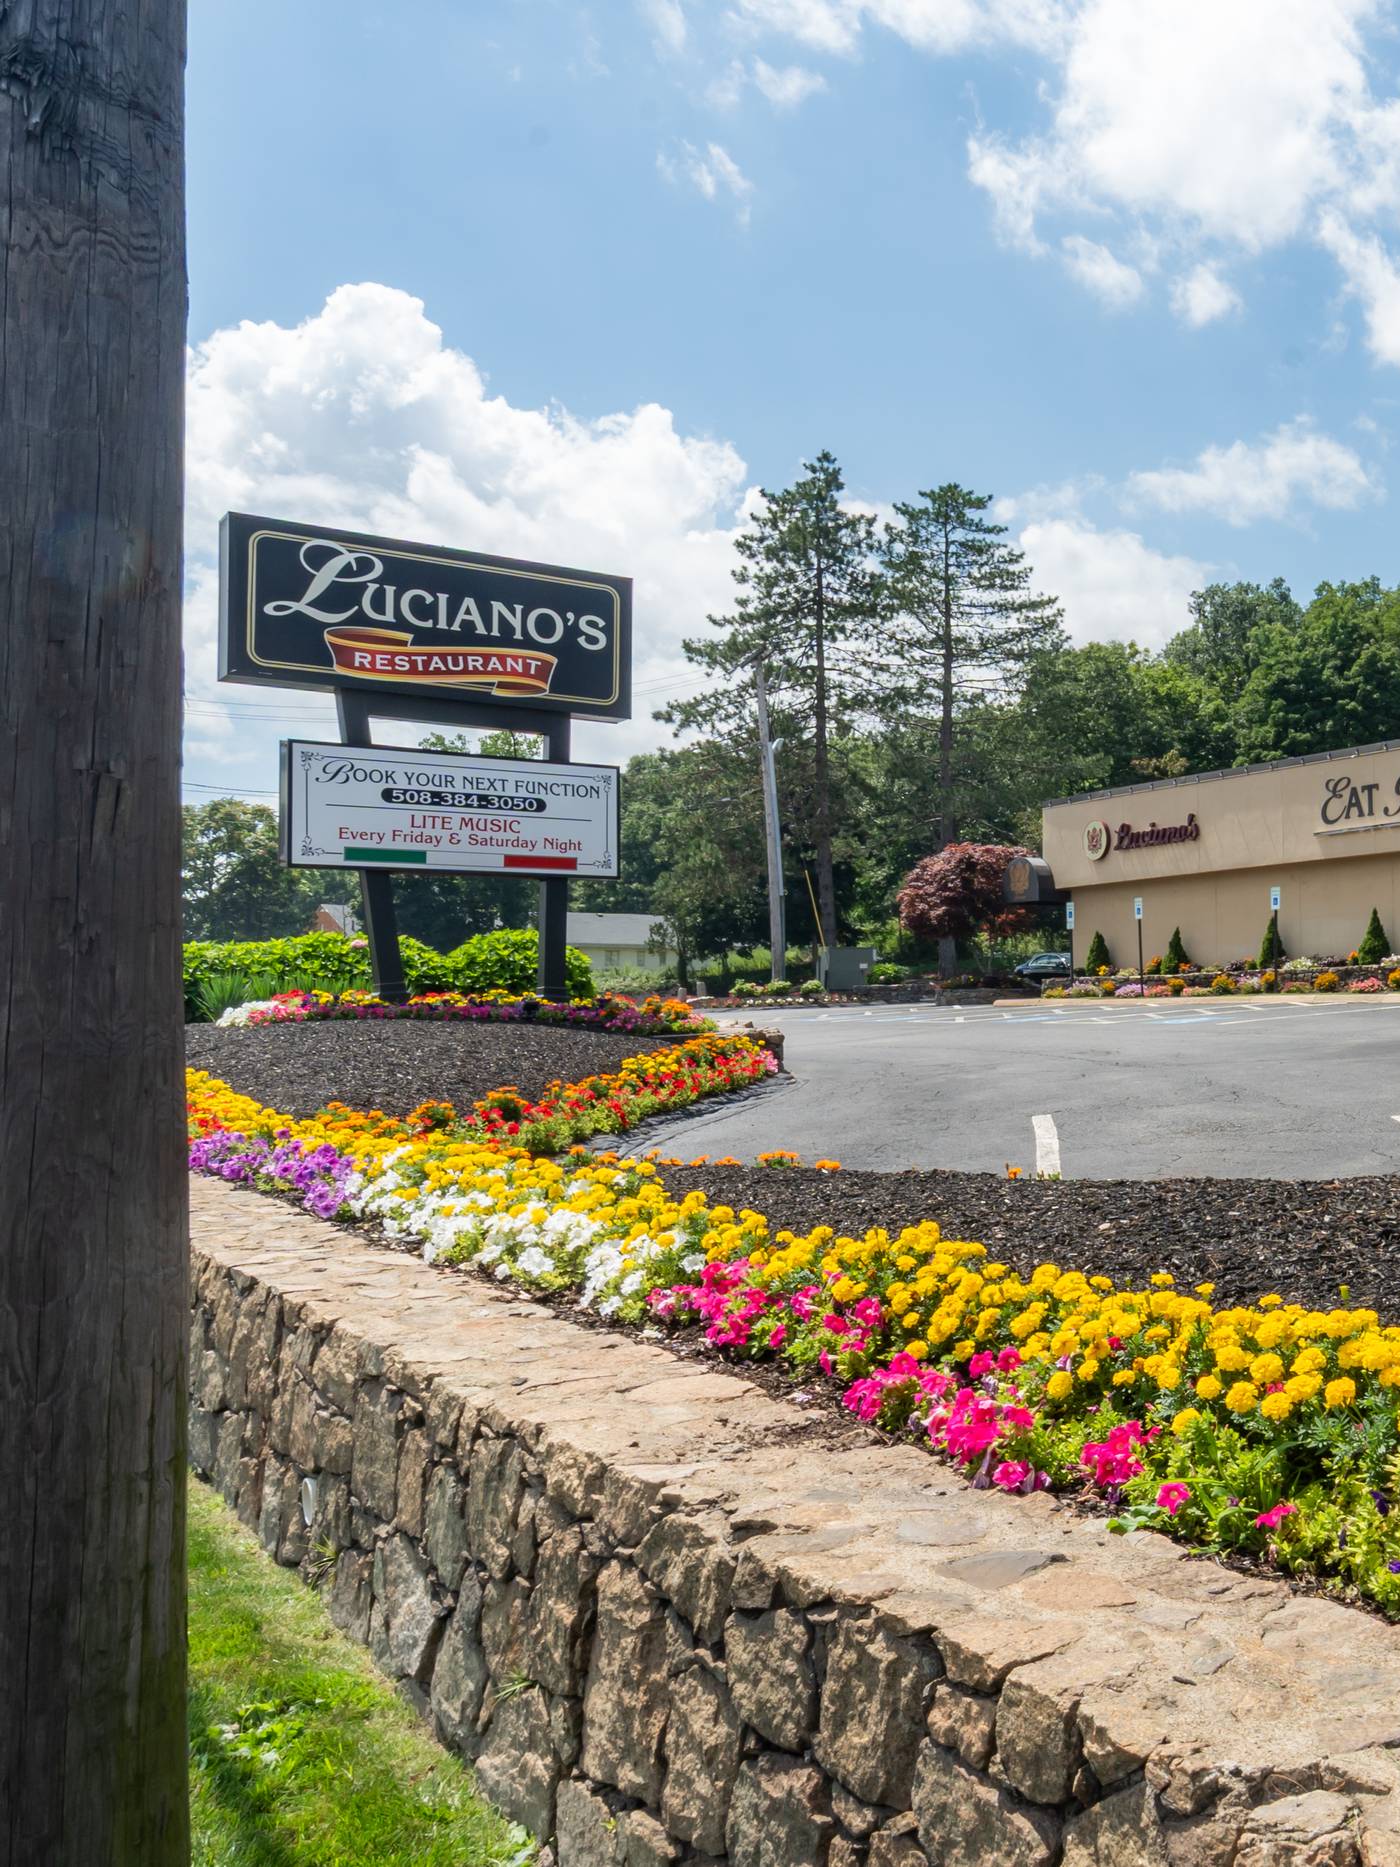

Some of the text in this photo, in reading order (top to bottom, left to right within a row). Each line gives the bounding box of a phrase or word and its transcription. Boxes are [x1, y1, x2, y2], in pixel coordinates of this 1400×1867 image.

[263, 539, 607, 651] LUCIANO'S
[353, 652, 542, 676] RESTAURANT
[315, 760, 600, 799] BOOK YOUR NEXT FUNCTION
[391, 789, 537, 811] 508-384-3050
[1321, 776, 1379, 824] EAT
[410, 814, 521, 834] LITE MUSIC
[338, 827, 583, 854] Every Friday & Saturday Night
